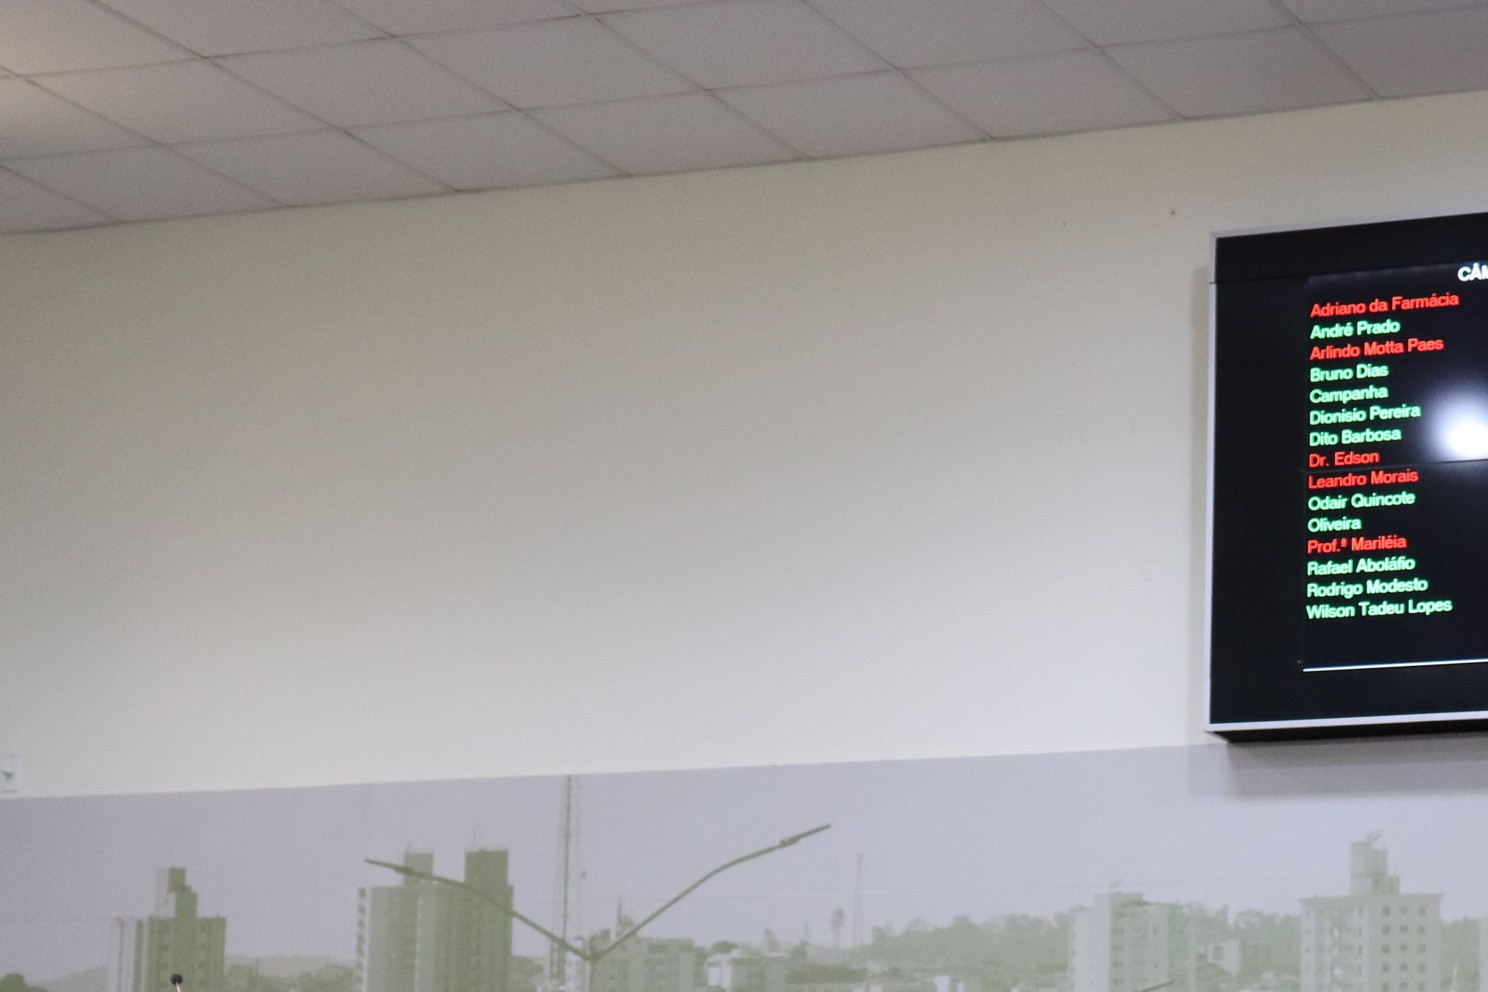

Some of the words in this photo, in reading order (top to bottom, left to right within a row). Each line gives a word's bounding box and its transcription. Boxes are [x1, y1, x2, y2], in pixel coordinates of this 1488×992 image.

[1311, 302, 1368, 317] Adriano
[1367, 299, 1389, 313] da
[1392, 292, 1460, 310] Farmácia
[1310, 322, 1354, 339] André
[1357, 319, 1400, 335] Prado
[1310, 344, 1361, 360] Arlindo
[1364, 341, 1405, 356] Motta
[1408, 338, 1444, 352] Paes
[1310, 367, 1354, 382] Bruno
[1356, 363, 1389, 378] Dias
[1310, 385, 1389, 404] Campanha
[1370, 404, 1423, 424] Pereira
[1310, 432, 1339, 446] Dito
[1342, 428, 1402, 444] Barbosa
[1309, 454, 1329, 468] Dr.
[1334, 451, 1380, 466] Edson
[1308, 473, 1368, 489] Leandro
[1371, 469, 1419, 484] Morais
[1308, 495, 1348, 510] Odair
[1351, 491, 1416, 508] Quincote
[1308, 516, 1362, 532] Oliveira
[1351, 535, 1407, 551] Mariléia
[1307, 559, 1353, 576] Rafael
[1356, 556, 1416, 573] Aboláfio
[1307, 581, 1363, 599] Rodrigo
[1366, 578, 1428, 594] Modesto
[1306, 604, 1355, 619] Wilson
[1358, 601, 1405, 616] Tadeu
[1408, 599, 1453, 615] Lopes
